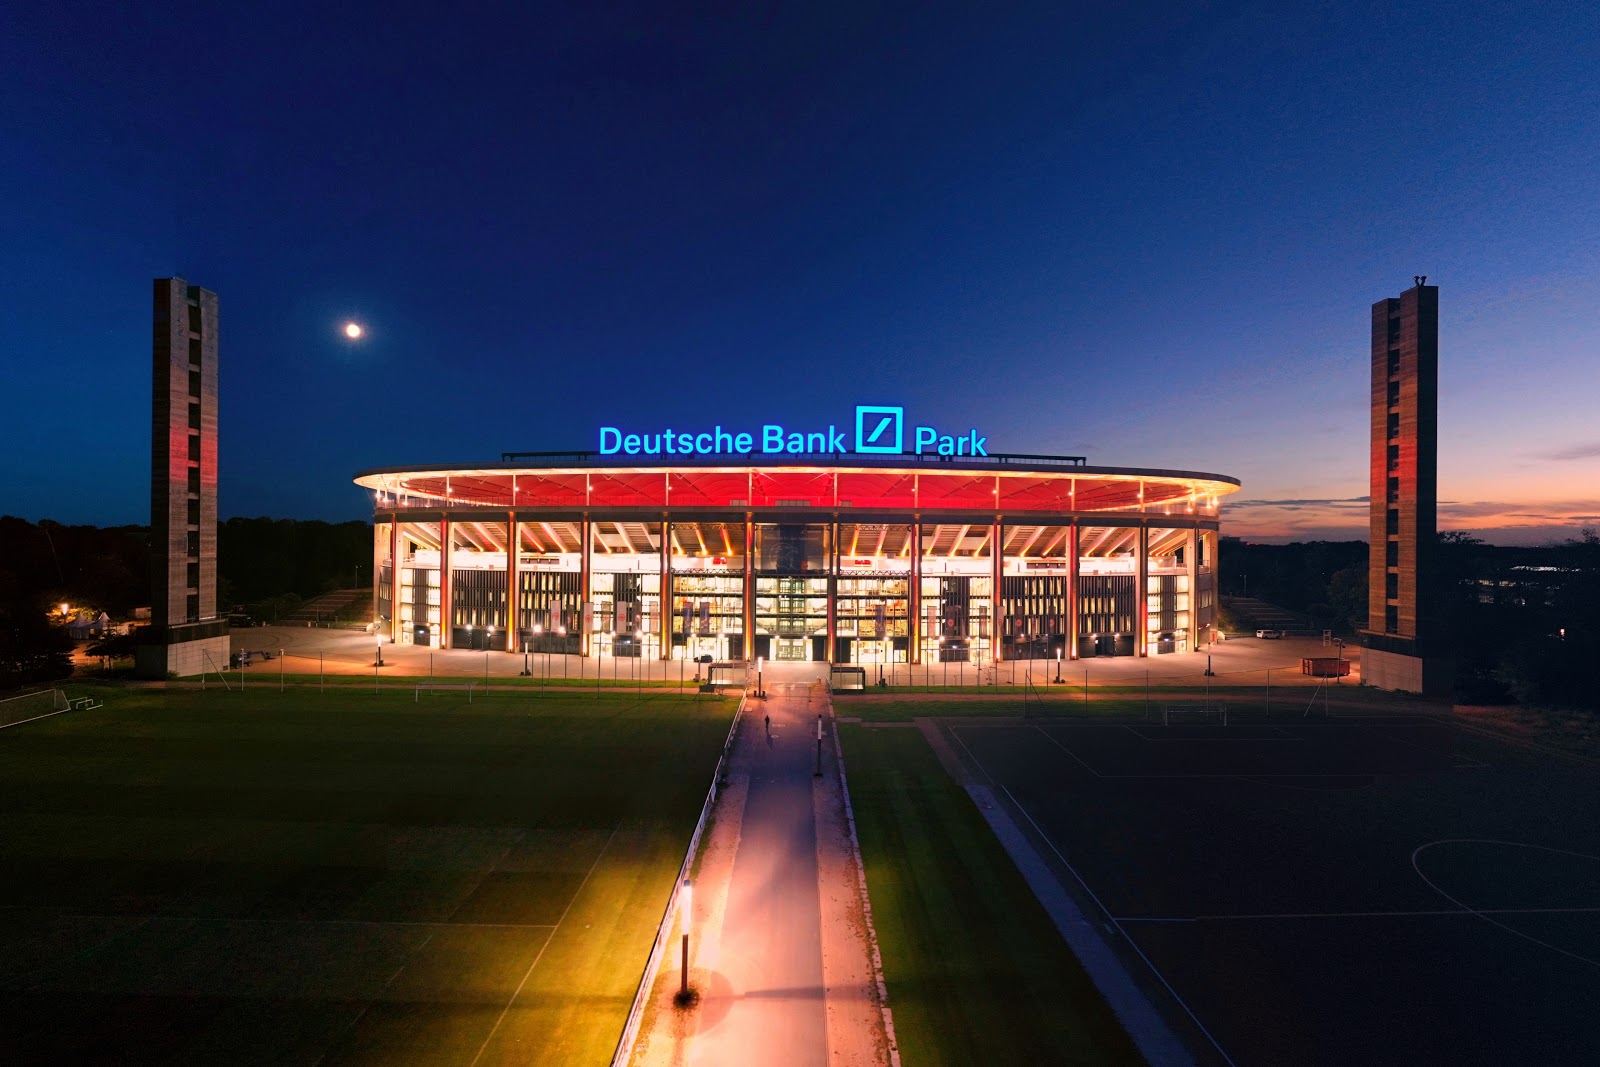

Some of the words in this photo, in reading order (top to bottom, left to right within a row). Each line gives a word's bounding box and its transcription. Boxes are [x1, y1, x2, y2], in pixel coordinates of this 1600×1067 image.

[599, 426, 754, 455] Deutsche
[762, 425, 847, 454] Bank
[915, 426, 988, 457] Park
